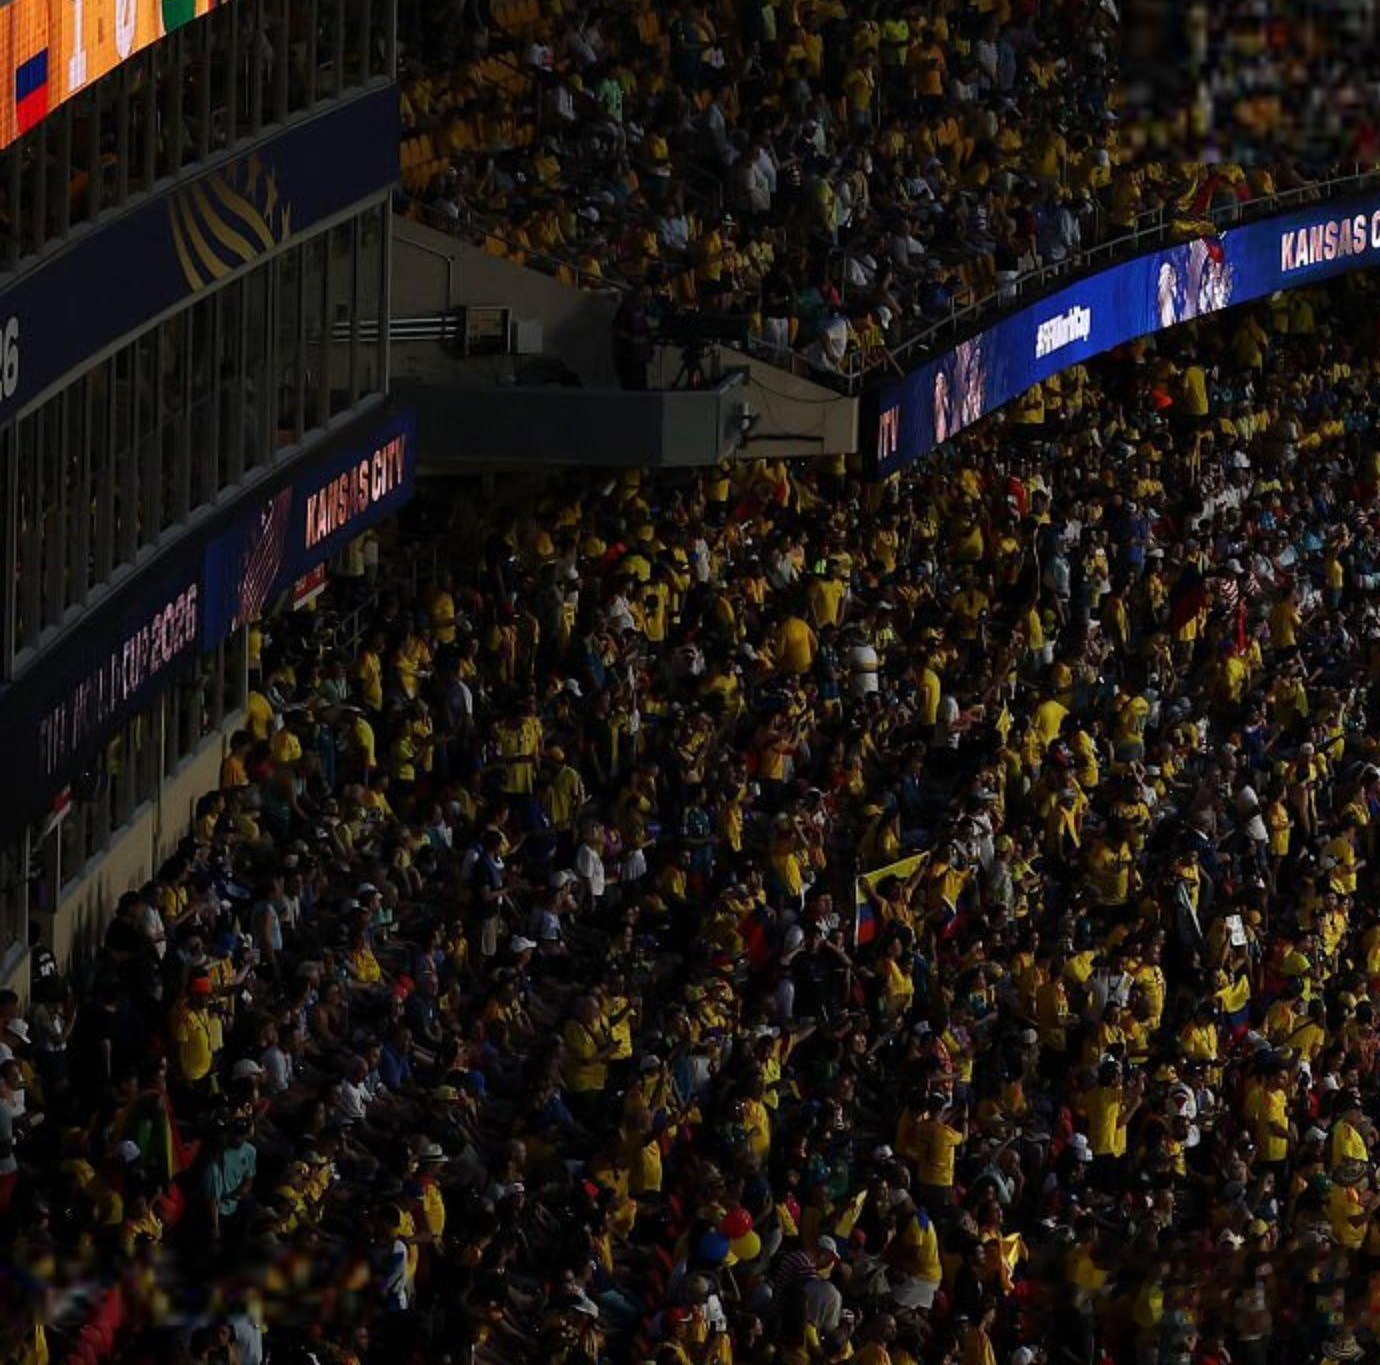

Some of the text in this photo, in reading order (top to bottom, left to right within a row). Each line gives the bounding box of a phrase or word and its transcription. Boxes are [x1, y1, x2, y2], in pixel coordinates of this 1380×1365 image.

[1281, 214, 1368, 272] KANSAS
[305, 433, 407, 550] KANSAS CITY
